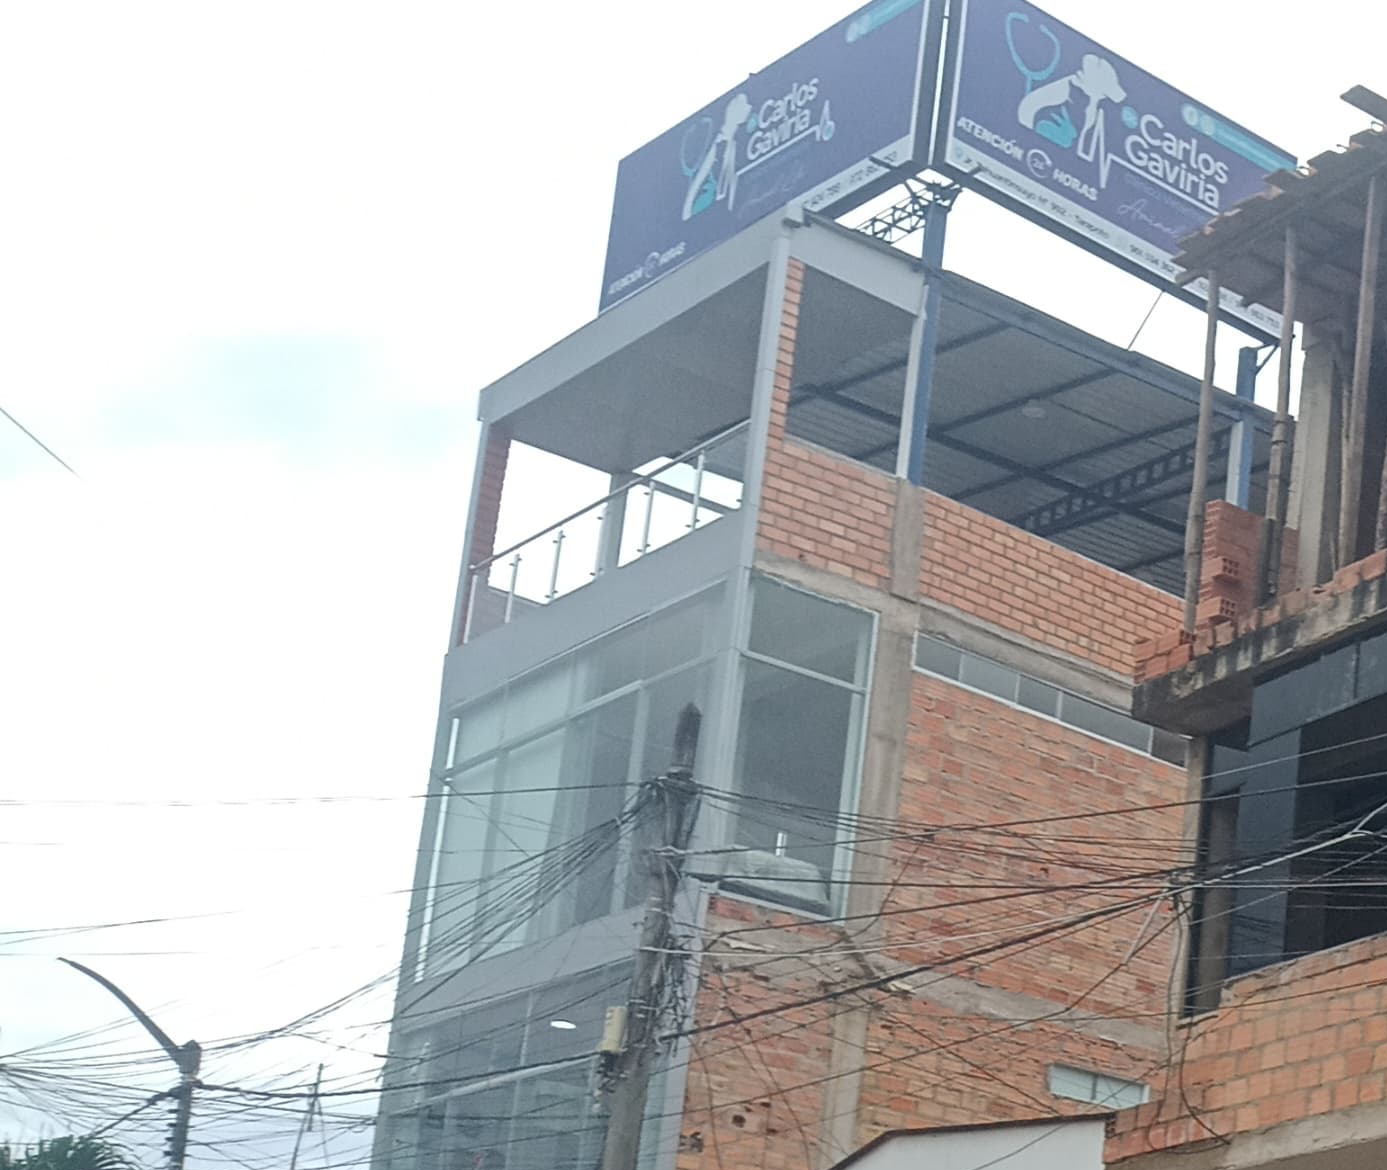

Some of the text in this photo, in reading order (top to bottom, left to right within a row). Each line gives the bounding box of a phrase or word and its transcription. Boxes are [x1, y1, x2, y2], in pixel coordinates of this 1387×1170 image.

[747, 109, 810, 160] Gaviria
[759, 78, 819, 129] Carlos
[957, 116, 1025, 161] ATENCIÓN
[1053, 168, 1098, 201] HORAS
[1125, 135, 1220, 209] Gaviria
[1140, 114, 1229, 184] Carlos
